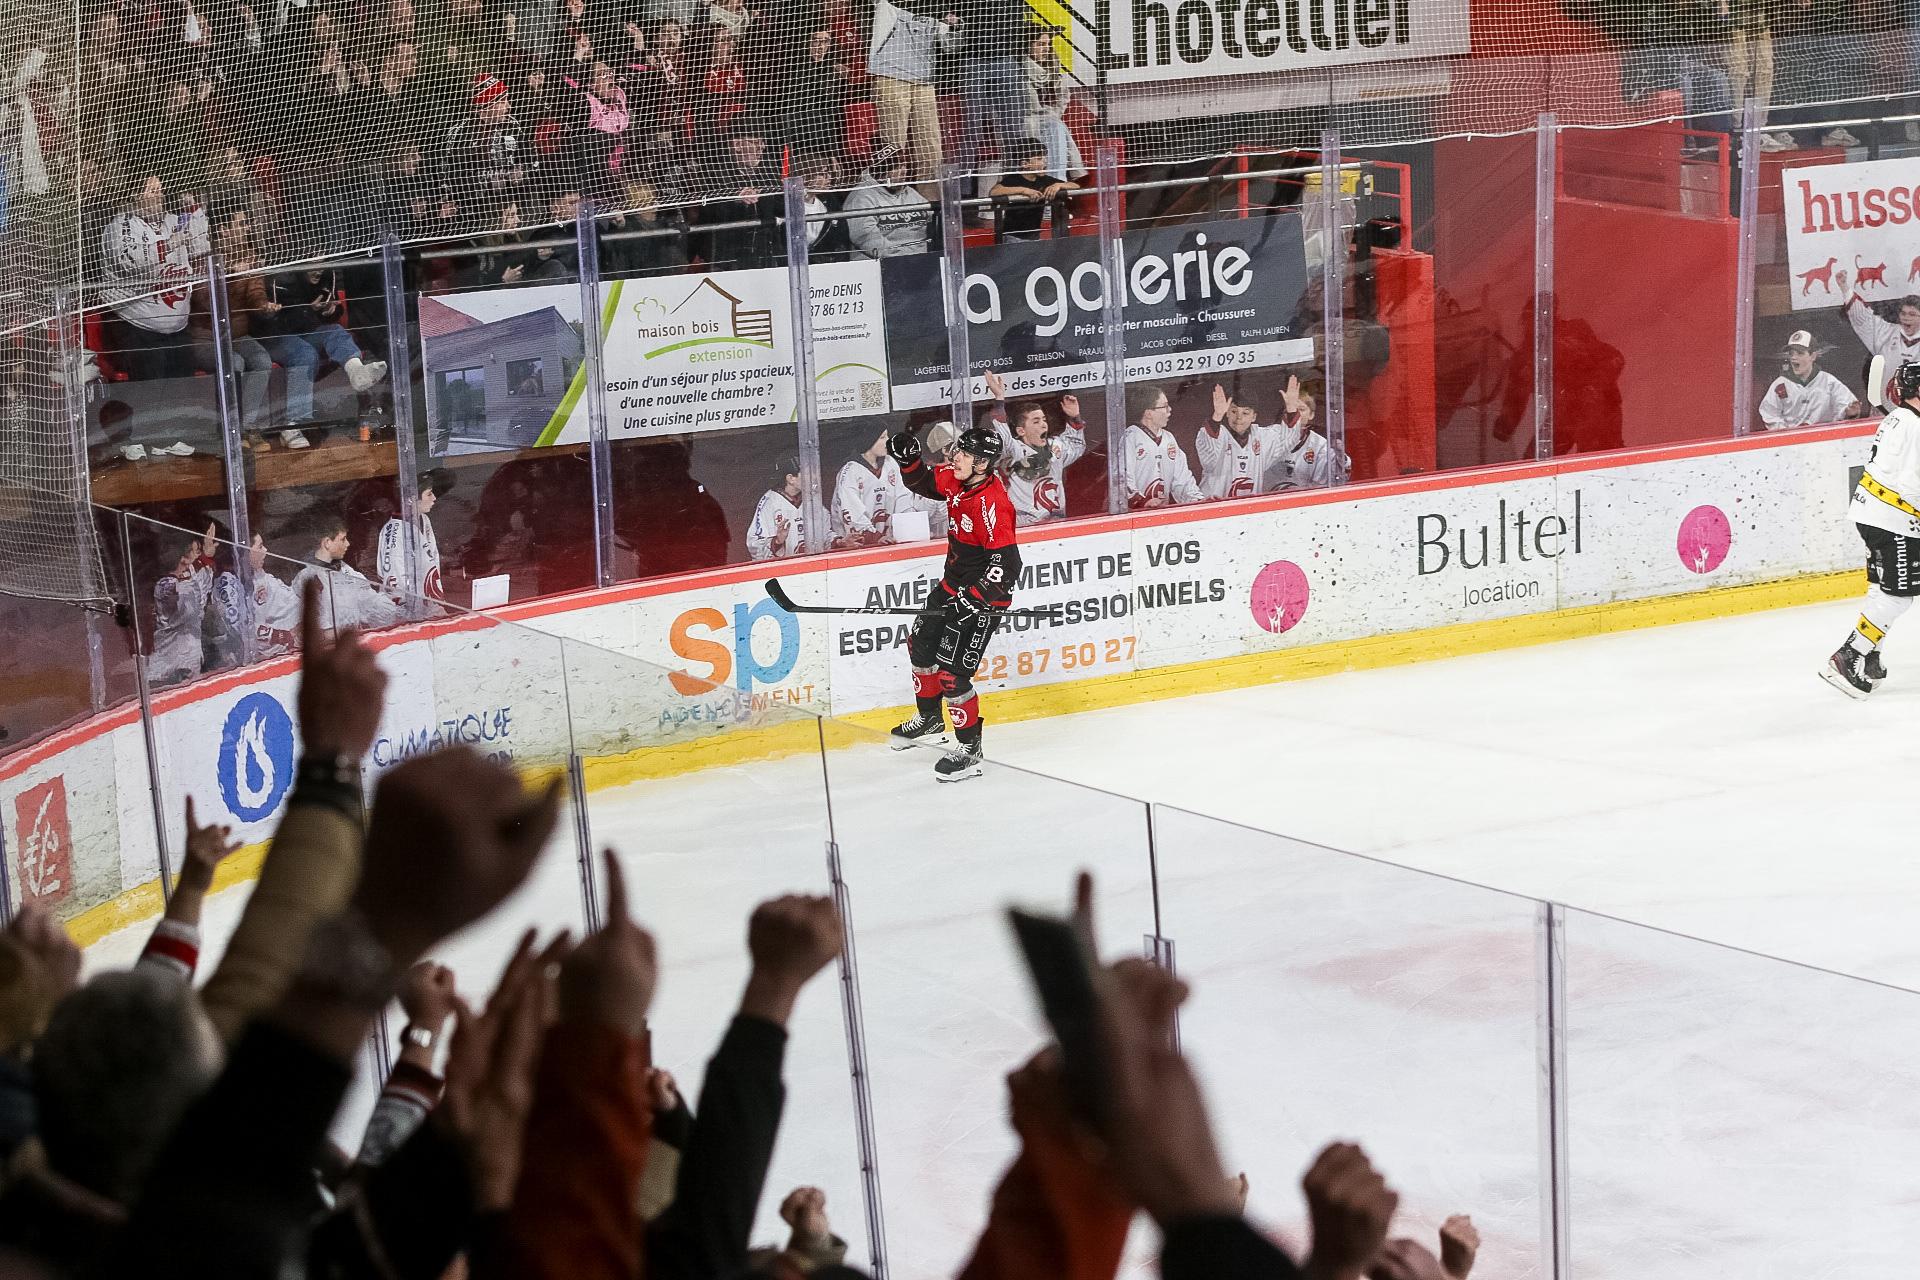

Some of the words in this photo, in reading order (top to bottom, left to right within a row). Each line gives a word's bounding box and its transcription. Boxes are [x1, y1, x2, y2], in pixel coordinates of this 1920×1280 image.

[809, 286, 830, 299] ôme
[833, 283, 862, 297] DENIS
[939, 257, 1001, 327] la
[1024, 233, 1253, 337] galerie
[822, 303, 835, 316] 86
[838, 302, 849, 315] 12
[852, 301, 864, 313] 13
[1074, 324, 1096, 336] Prêt
[1143, 314, 1188, 329] masculin
[1198, 308, 1255, 323] Chaussures
[638, 325, 685, 339] maison
[692, 320, 719, 334] bois
[689, 347, 753, 363] extension
[969, 359, 991, 369] HUGO
[993, 357, 1013, 367] BOSS
[1027, 351, 1065, 363] STRELLSON
[1140, 340, 1164, 350] JACOB
[1166, 336, 1193, 347] COHEN
[1206, 332, 1228, 342] DIESEL
[1241, 328, 1262, 338] RALPH
[1264, 325, 1290, 336] LAUREN
[606, 377, 639, 392] esoin
[671, 372, 709, 389] séjour
[712, 369, 737, 385] plus
[740, 364, 795, 380] spacieux,
[1012, 377, 1036, 391] des
[1039, 370, 1098, 388] Sergents
[1155, 361, 1172, 373] 03
[1176, 358, 1194, 370] 22
[1198, 355, 1212, 368] 91
[1217, 354, 1234, 366] 09
[1238, 351, 1255, 363] 35
[656, 390, 708, 407] nouvelle
[711, 385, 764, 400] chambre
[767, 383, 774, 395] ?
[623, 416, 647, 429] Une
[651, 411, 693, 426] cuisine
[696, 409, 721, 426] plus
[724, 404, 766, 423] grande
[769, 404, 776, 415] ?
[1417, 489, 1581, 575] Bultel
[1097, 552, 1132, 580] DE
[1146, 540, 1201, 568] VOS
[1893, 535, 1908, 590] matmut
[1464, 579, 1540, 608] location
[839, 623, 910, 656] ESPA
[994, 578, 1225, 635] ROFESSIONNELS
[668, 597, 800, 697] sp
[1017, 648, 1050, 676] 87
[1062, 642, 1096, 670] 50
[1105, 635, 1137, 664] 27
